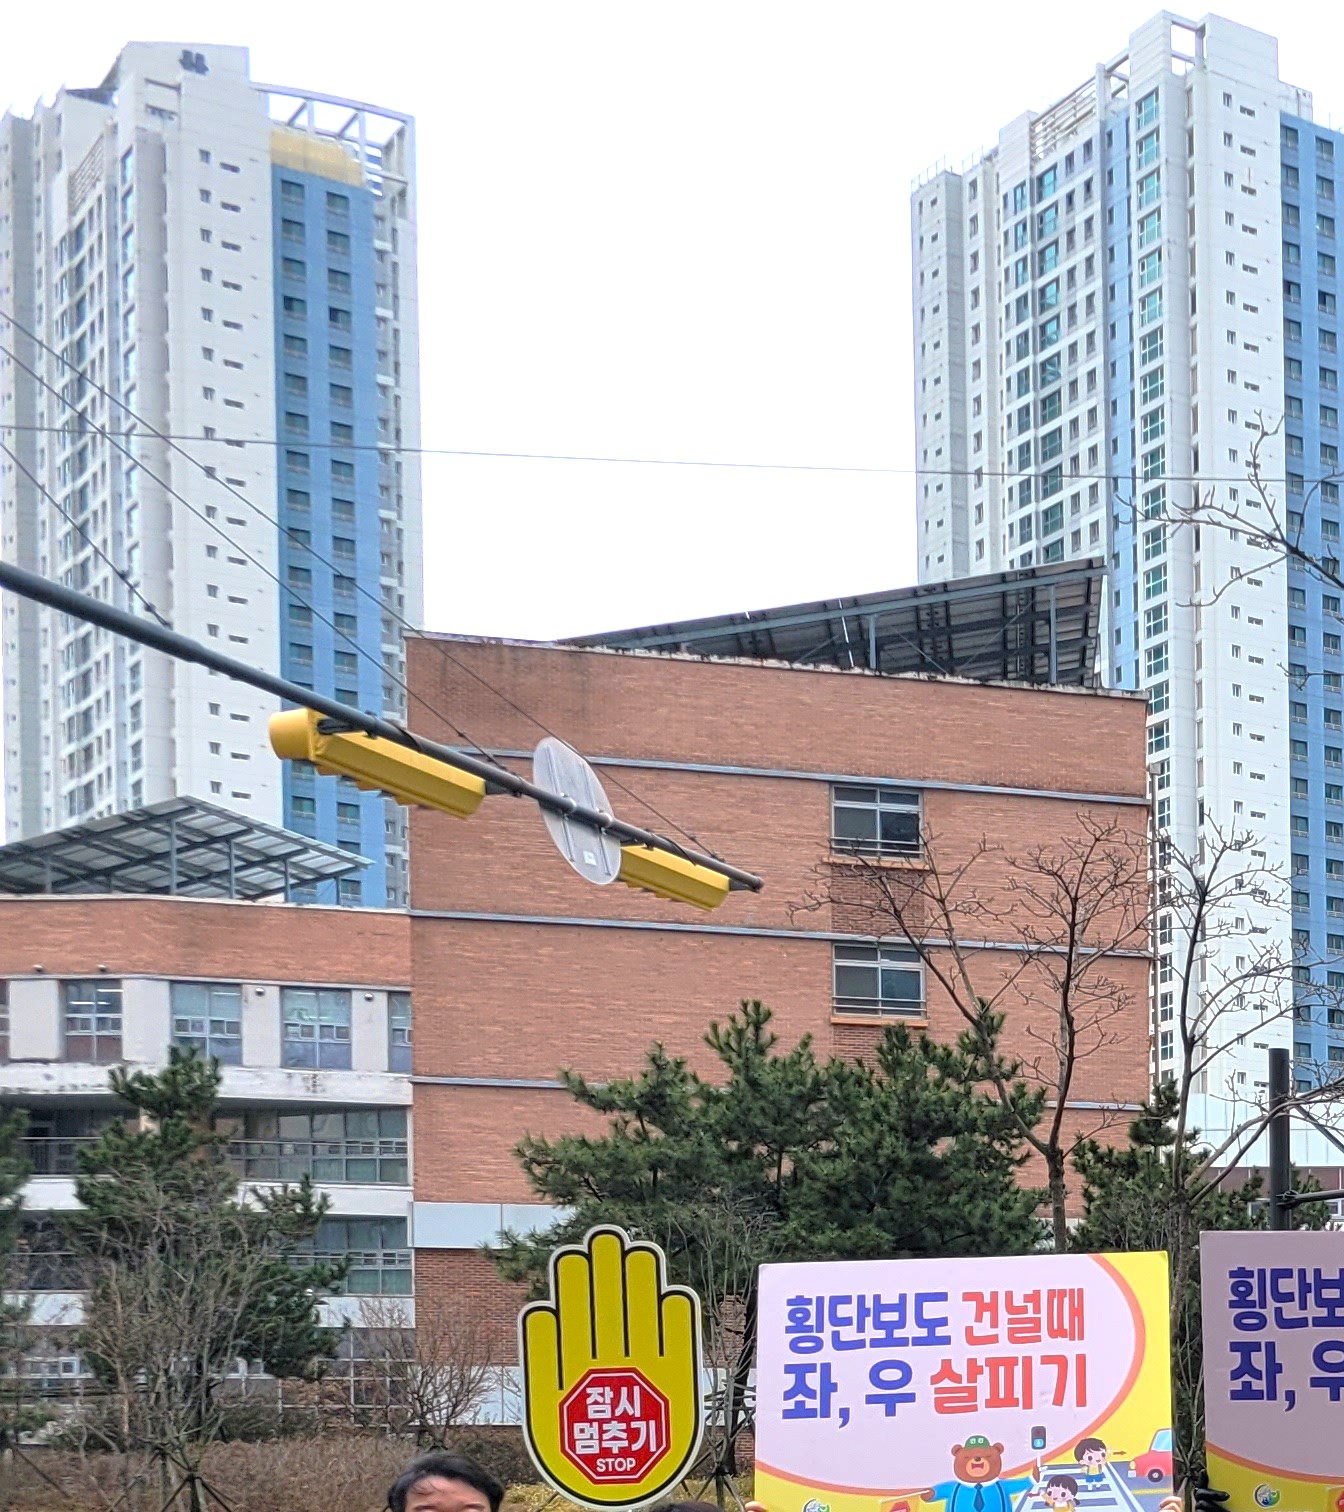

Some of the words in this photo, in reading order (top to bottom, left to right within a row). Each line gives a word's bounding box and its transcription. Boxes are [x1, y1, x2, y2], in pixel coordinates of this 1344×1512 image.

[784, 1291, 952, 1354] 횡단보도
[962, 1287, 1085, 1346] 건널때
[585, 1385, 641, 1419] 잠시
[865, 1358, 916, 1418] 우
[929, 1353, 1088, 1415] 살피기
[573, 1420, 656, 1454] 멈추기
[596, 1457, 636, 1472] STOP
